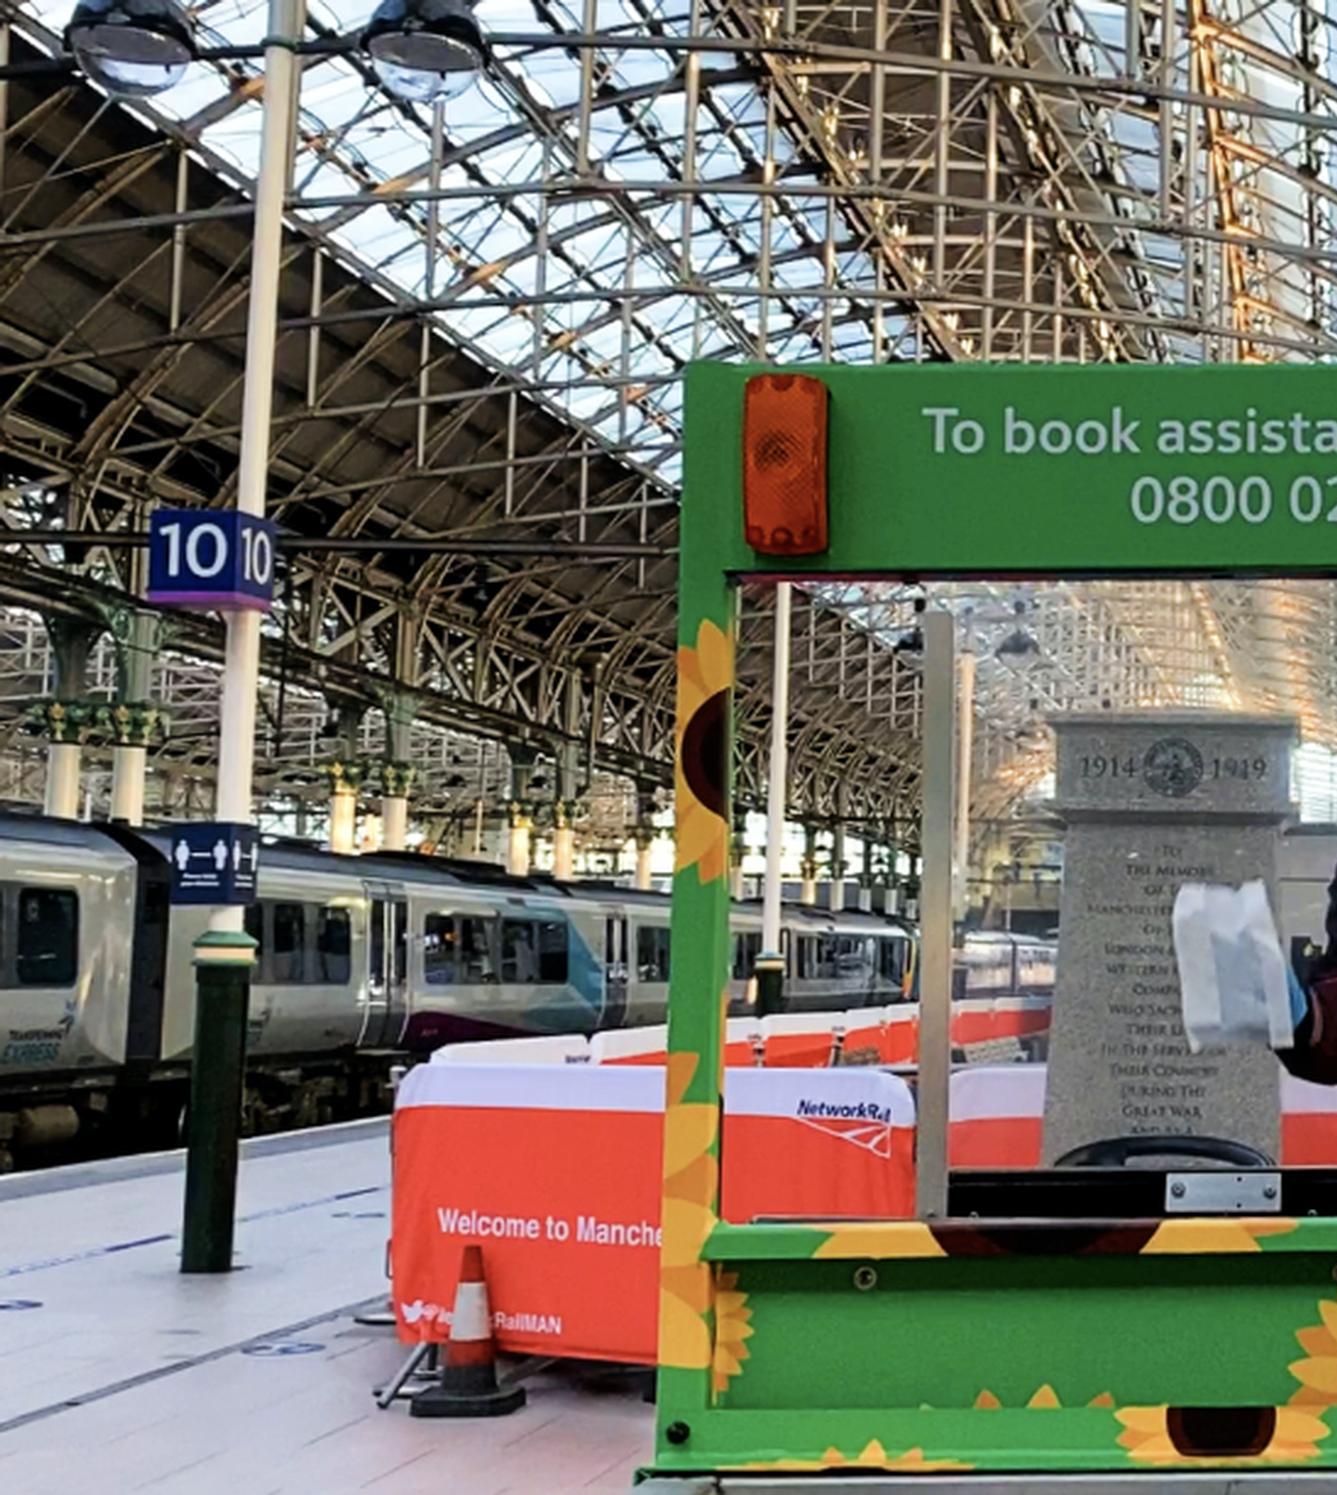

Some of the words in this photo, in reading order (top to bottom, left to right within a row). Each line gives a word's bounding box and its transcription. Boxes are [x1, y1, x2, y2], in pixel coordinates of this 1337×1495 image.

[921, 406, 985, 455] To
[1004, 405, 1141, 455] book
[1130, 476, 1272, 524] 0800
[159, 522, 228, 578] 10
[241, 527, 272, 585] 10
[1079, 756, 1139, 778] 1914
[1212, 757, 1267, 780] 1919
[797, 1100, 892, 1122] NetworkRil
[1122, 1104, 1166, 1118] GREAT
[437, 1207, 540, 1239] Welcome
[546, 1216, 569, 1241] to
